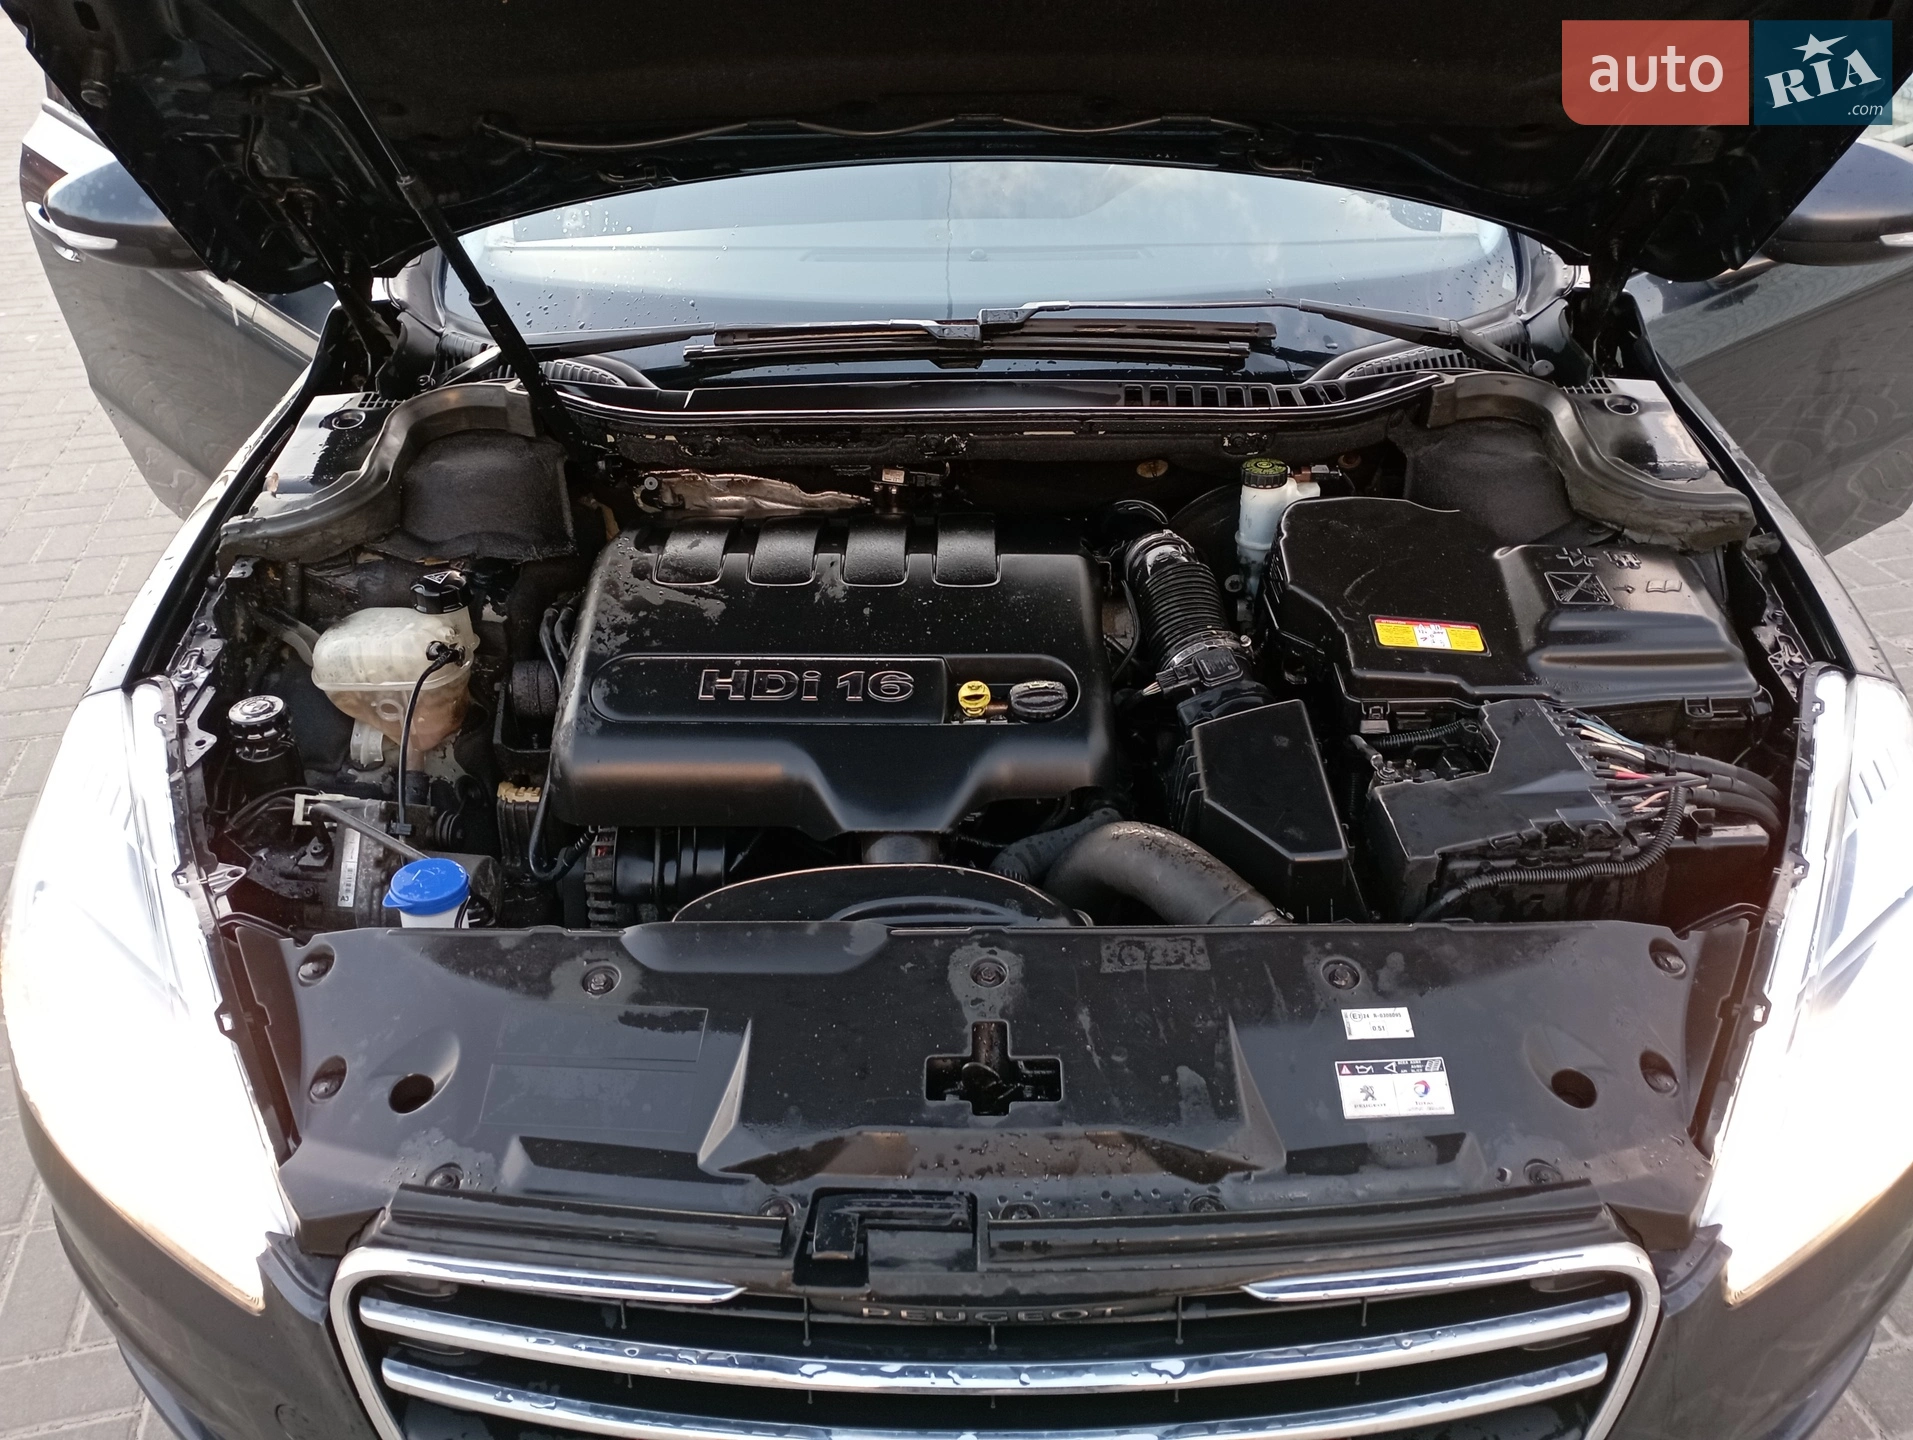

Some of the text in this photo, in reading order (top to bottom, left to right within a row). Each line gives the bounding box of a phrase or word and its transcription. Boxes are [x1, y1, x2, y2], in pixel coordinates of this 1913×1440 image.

[698, 669, 915, 703] HDi 16
[862, 1306, 1124, 1322] PEUGEOT
